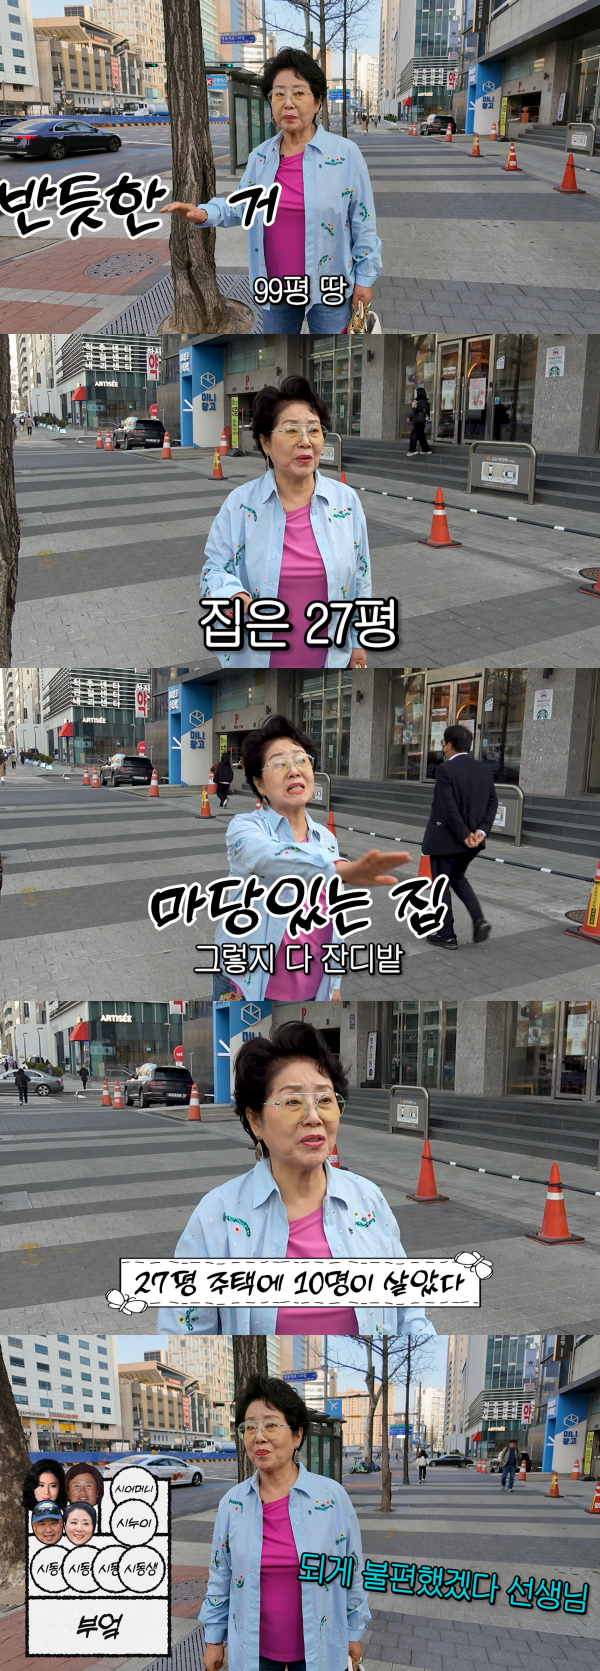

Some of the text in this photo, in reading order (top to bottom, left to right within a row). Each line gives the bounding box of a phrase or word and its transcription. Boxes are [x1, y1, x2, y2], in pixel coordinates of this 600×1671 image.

[148, 354, 158, 379] 약
[245, 376, 250, 386] P
[202, 393, 216, 402] 미니
[201, 402, 216, 411] 창고
[137, 691, 147, 716] 약
[235, 714, 239, 724] P
[190, 731, 205, 740] 미니
[190, 740, 205, 749] 창고
[100, 1013, 132, 1022] ARTISÉE
[524, 1405, 532, 1423] 약
